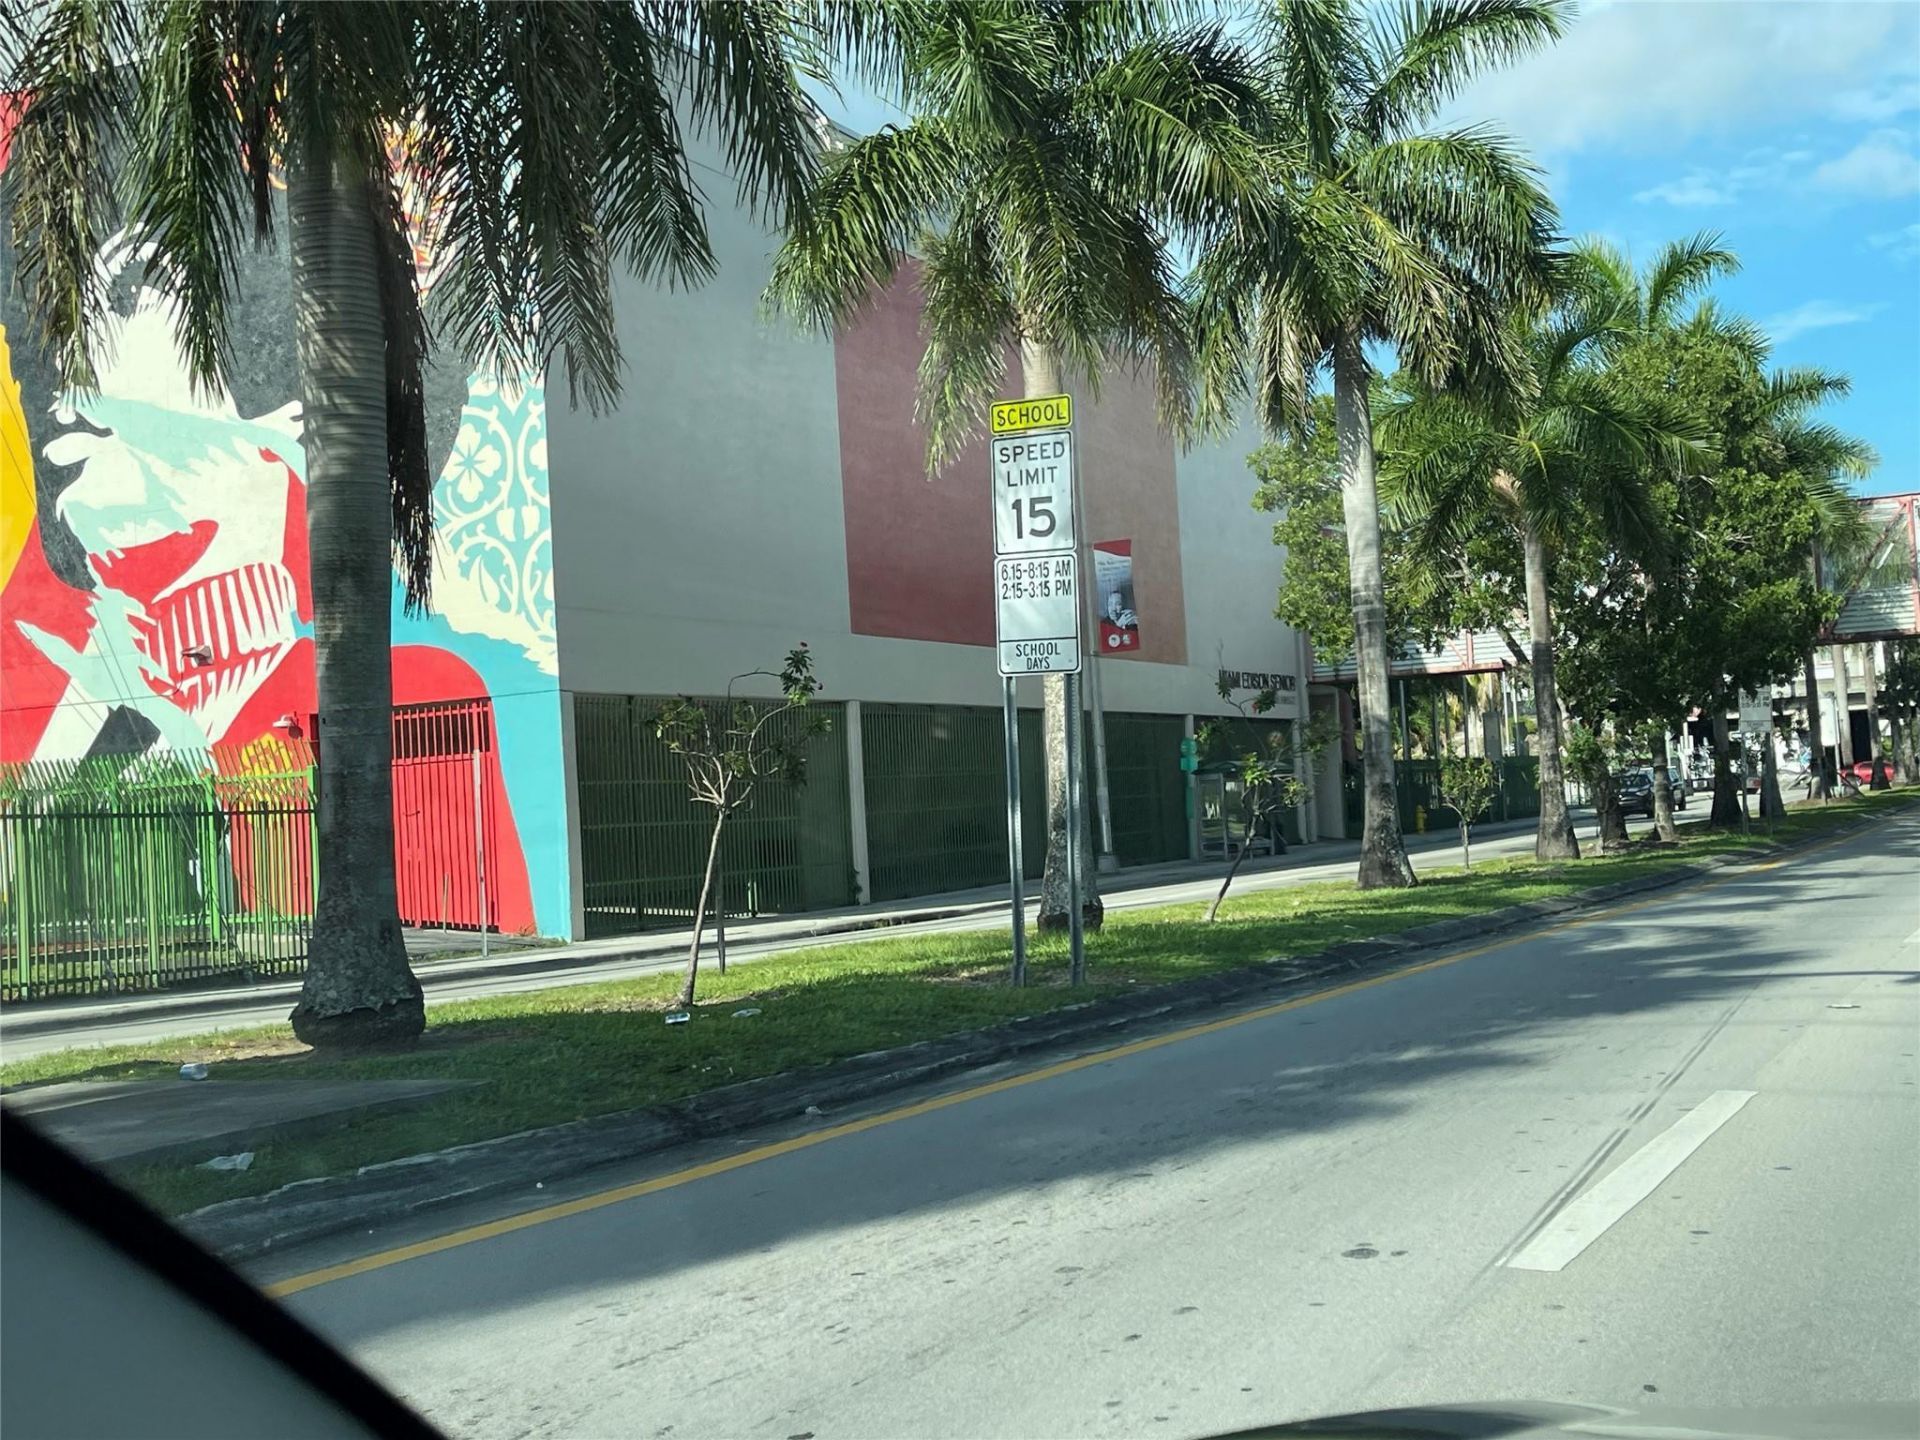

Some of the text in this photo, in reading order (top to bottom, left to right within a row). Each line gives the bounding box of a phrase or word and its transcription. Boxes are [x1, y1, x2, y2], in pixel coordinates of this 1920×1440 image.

[997, 403, 1066, 427] SCHOOL
[1000, 441, 1065, 464] SPEED
[1007, 466, 1058, 488] LIMIT
[1012, 496, 1056, 539] 15
[1055, 560, 1072, 578] AM
[1002, 579, 1072, 600] 2:15-3:15 PM
[1015, 642, 1062, 657] SCHOOL
[1026, 656, 1051, 670] DAYS
[1242, 672, 1270, 690] EDISON
